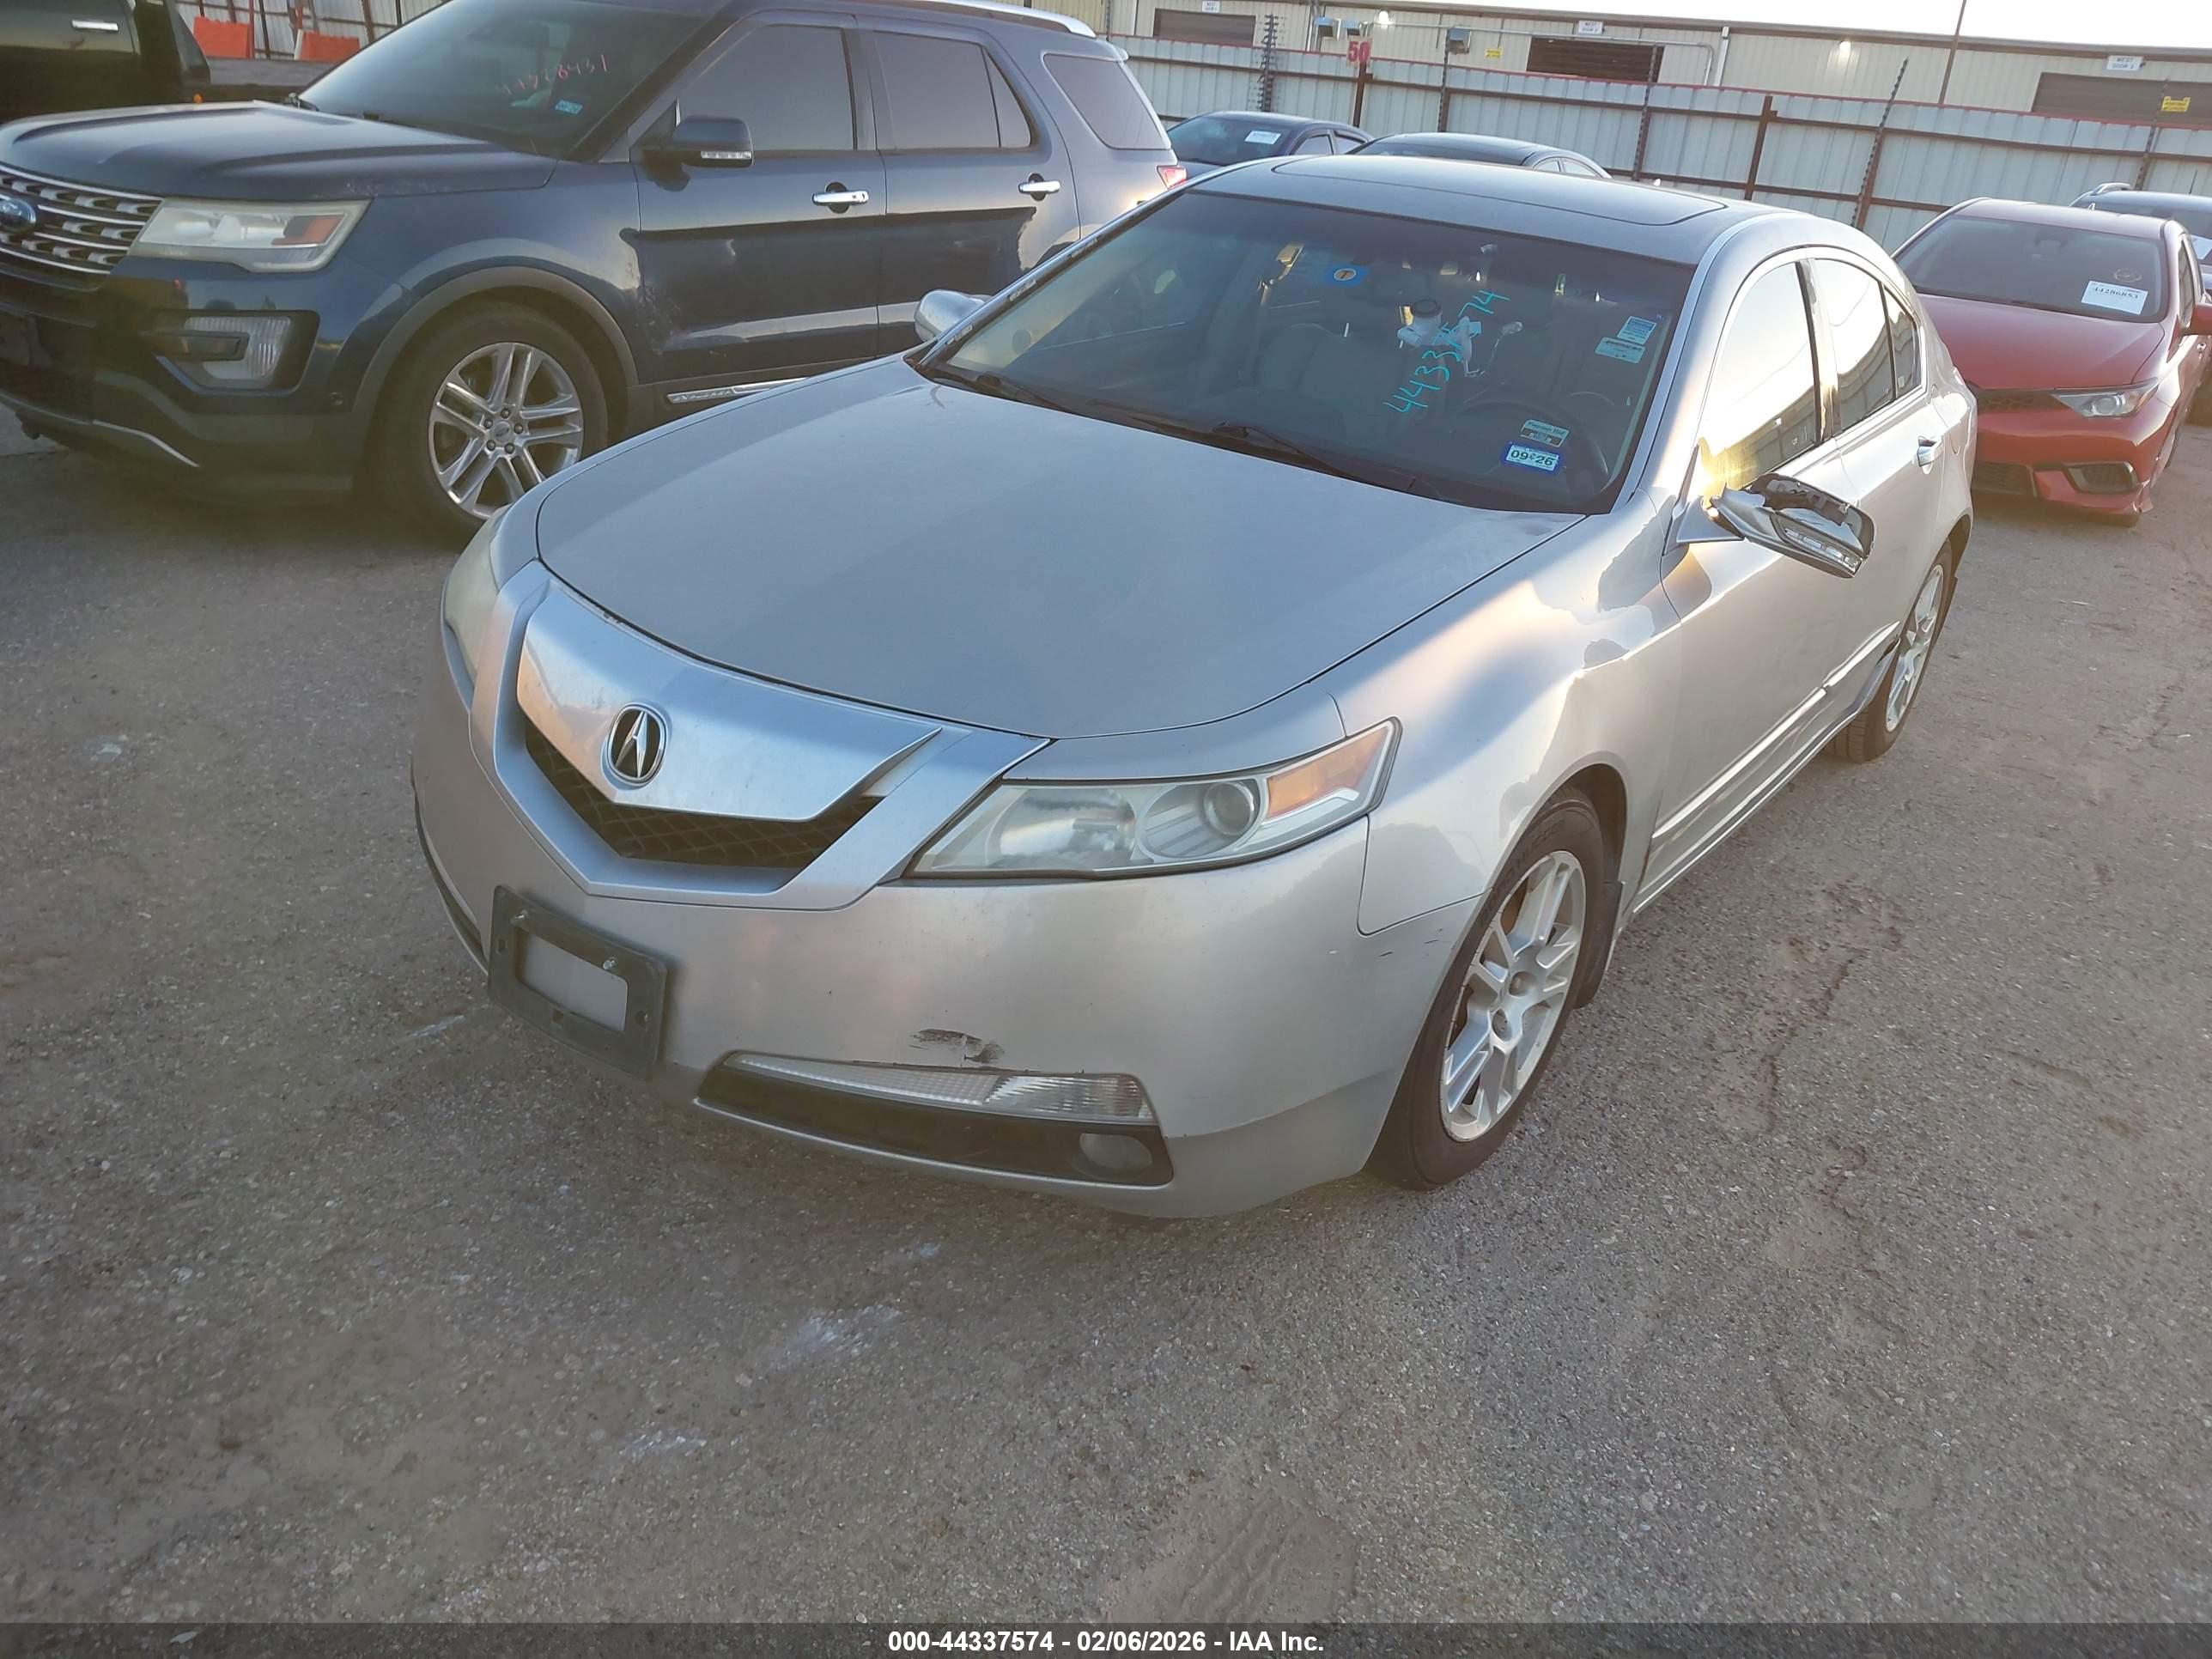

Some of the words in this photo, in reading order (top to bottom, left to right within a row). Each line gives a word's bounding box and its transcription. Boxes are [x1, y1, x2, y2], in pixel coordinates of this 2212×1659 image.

[1348, 40, 1370, 62] 50
[1511, 450, 1528, 460] 09
[1535, 455, 1555, 466] 26
